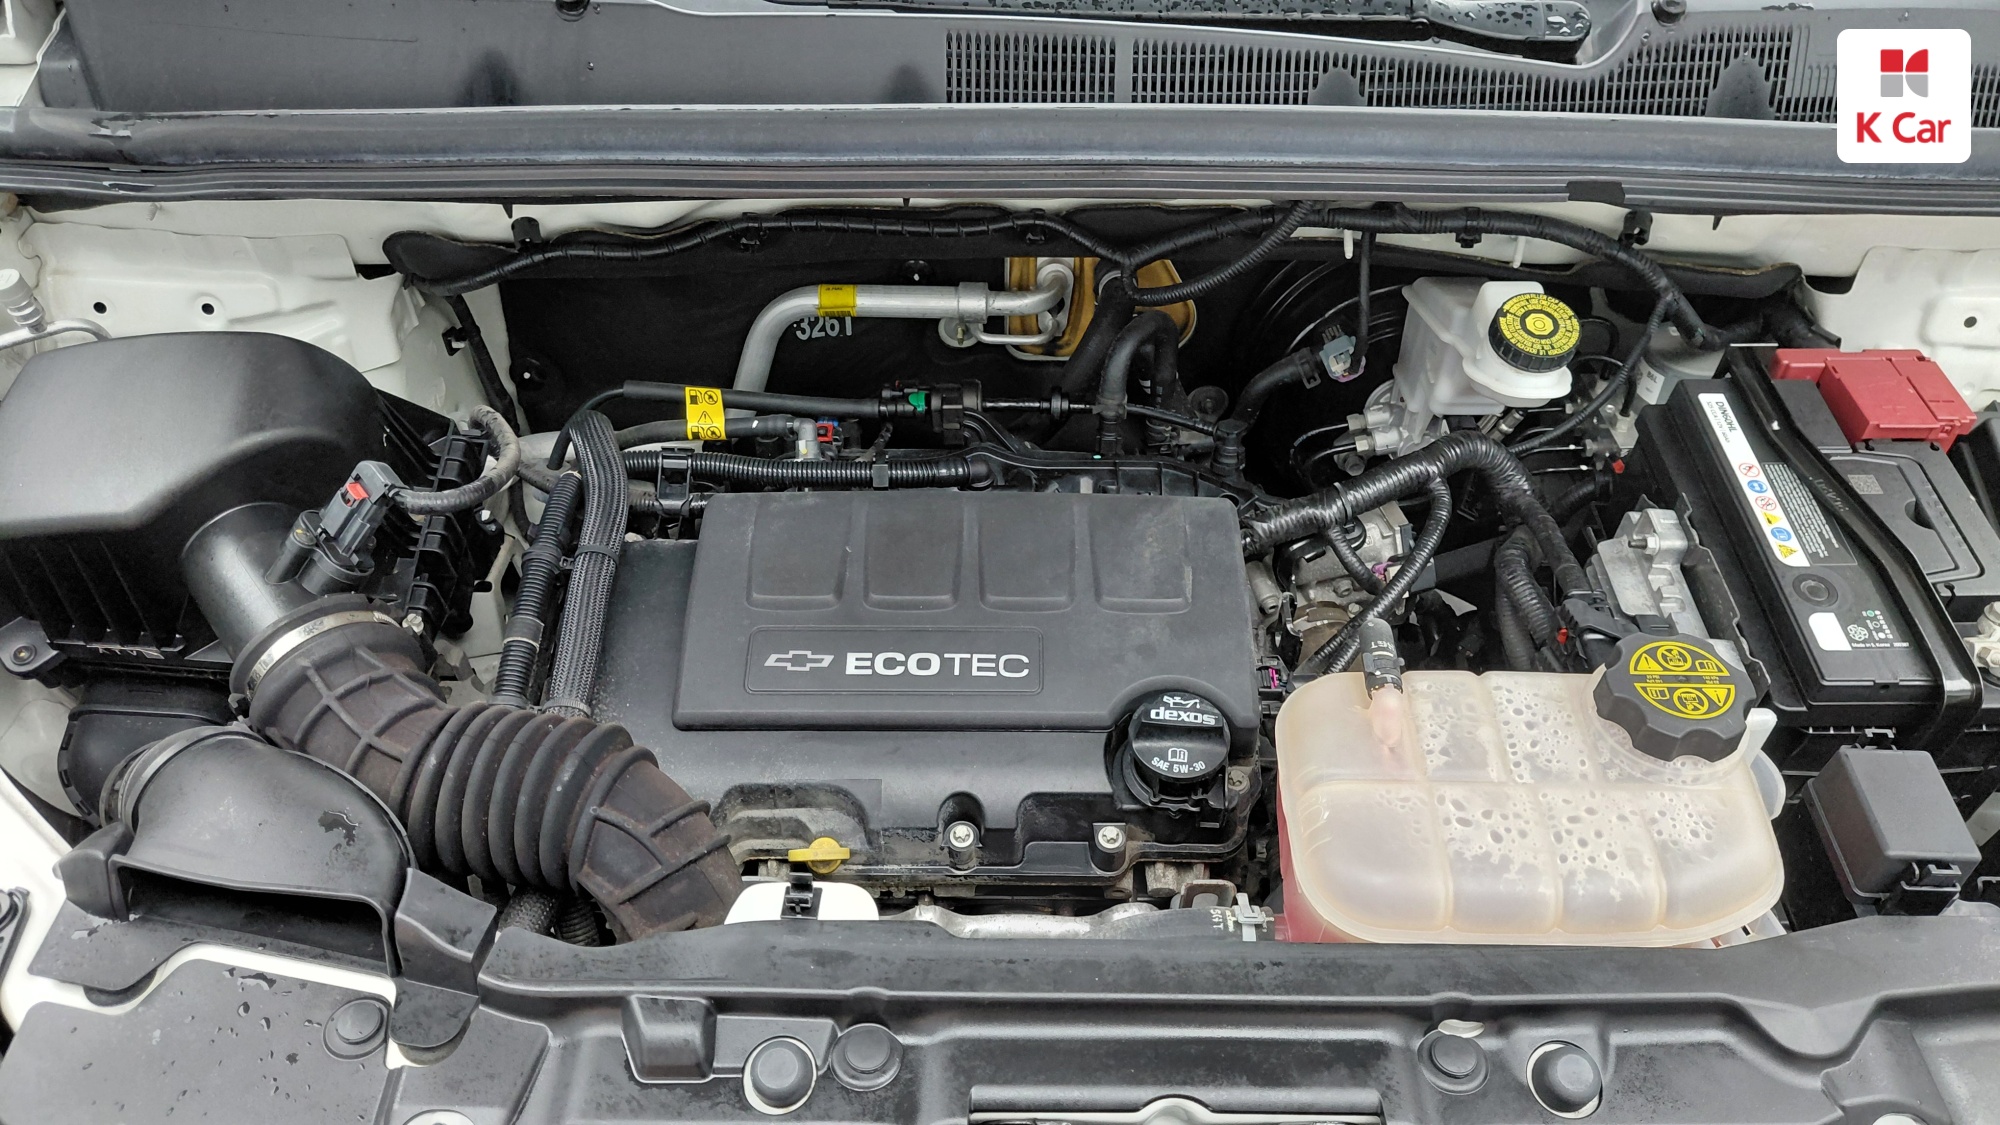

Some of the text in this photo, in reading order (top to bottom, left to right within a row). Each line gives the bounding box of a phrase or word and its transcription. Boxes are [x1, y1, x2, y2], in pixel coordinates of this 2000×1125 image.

[1715, 401, 1738, 433] DIN60HL
[845, 651, 1030, 678] ECOTEC
[1150, 706, 1217, 726] dexos
[1151, 756, 1206, 774] SAE 5W-30
